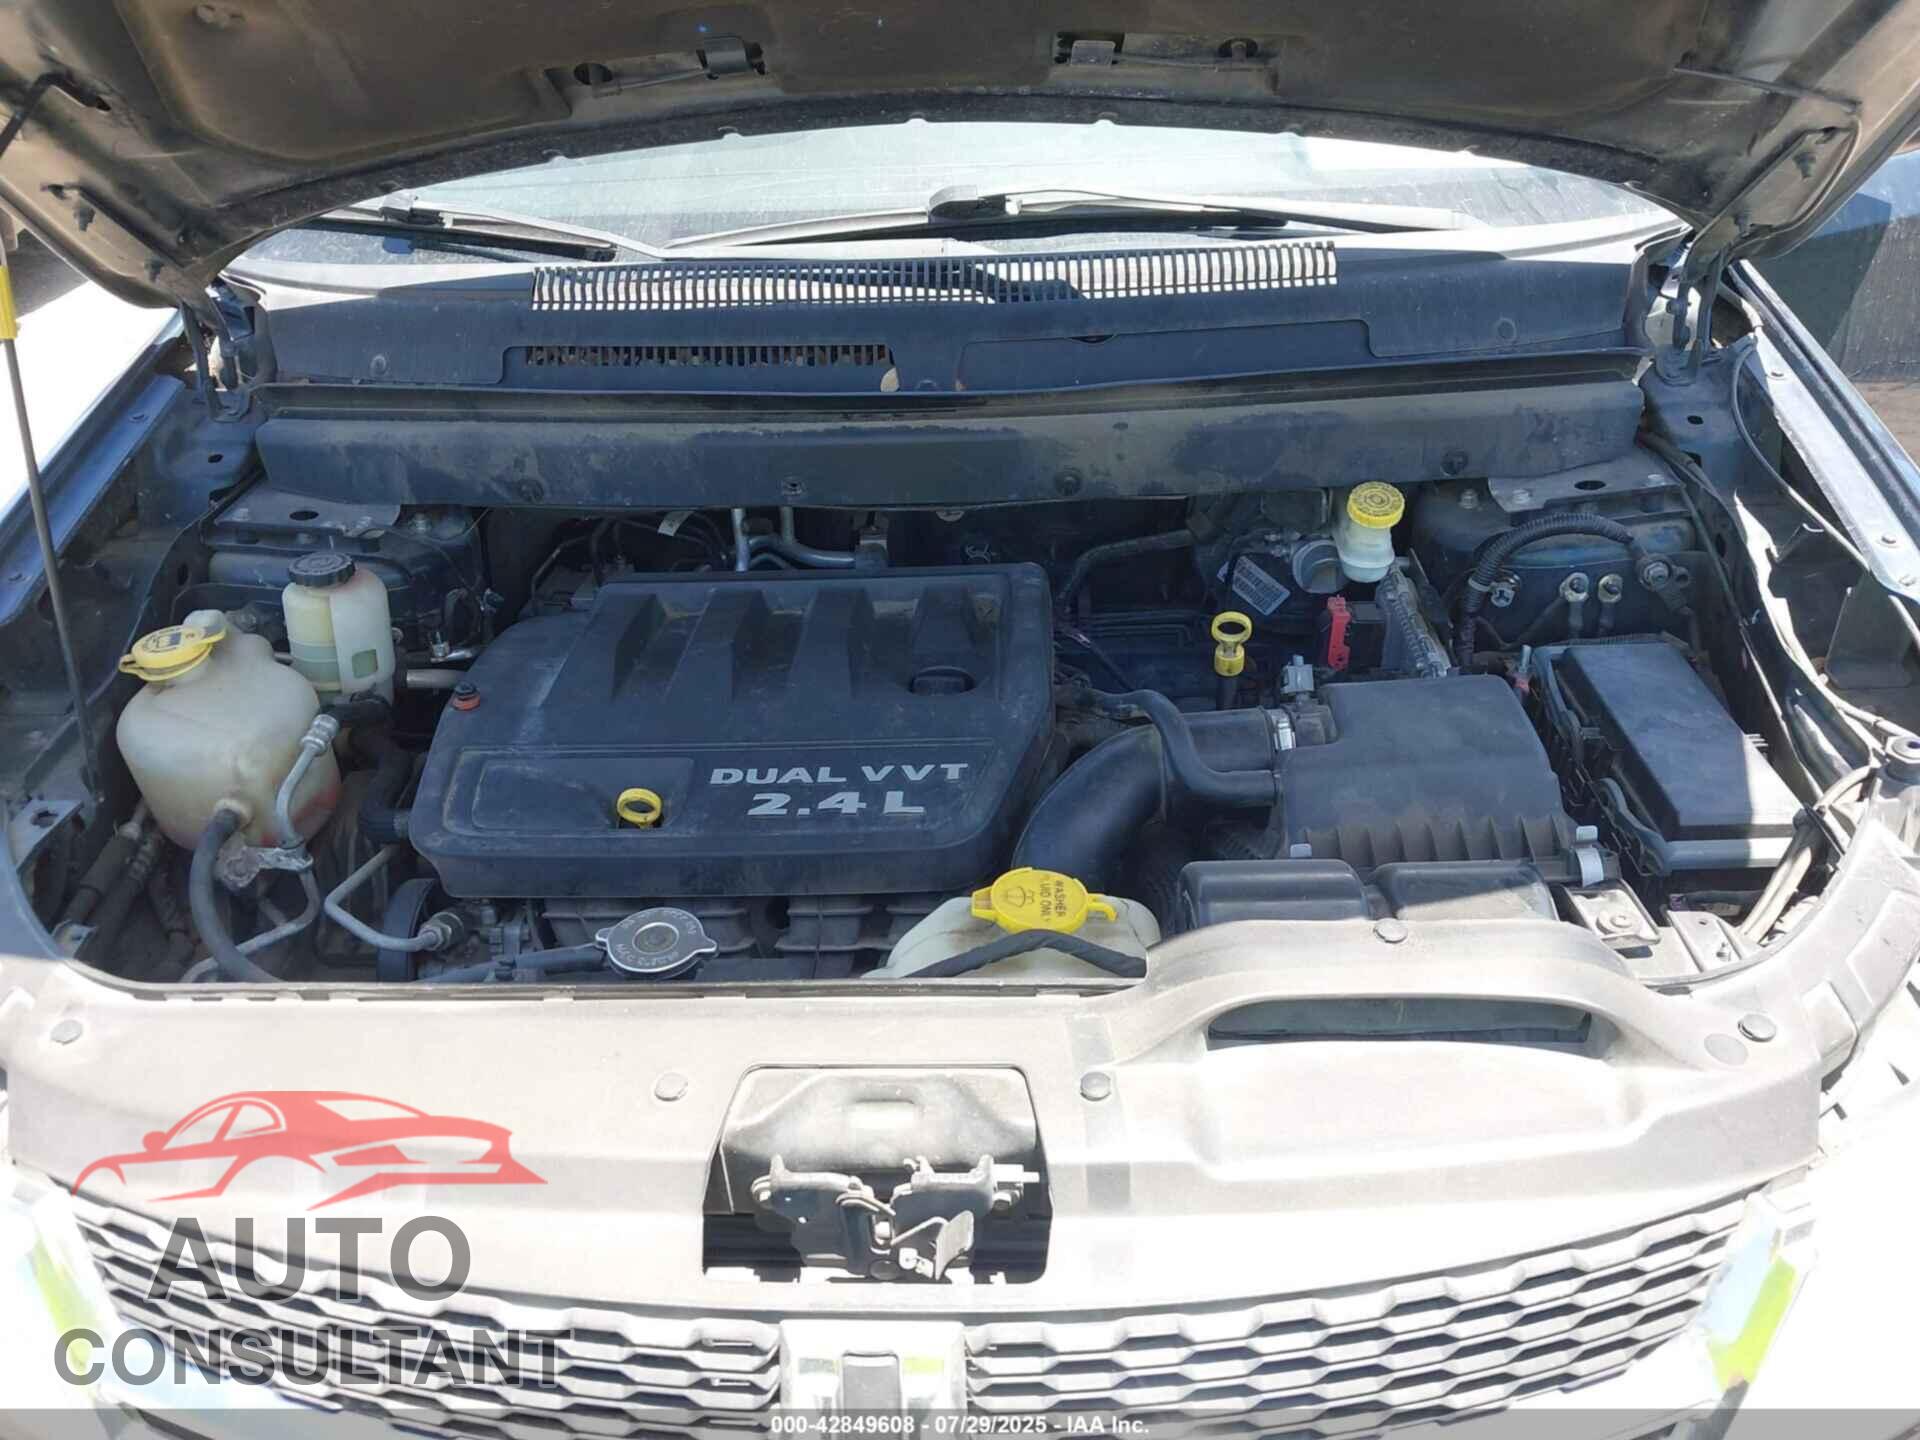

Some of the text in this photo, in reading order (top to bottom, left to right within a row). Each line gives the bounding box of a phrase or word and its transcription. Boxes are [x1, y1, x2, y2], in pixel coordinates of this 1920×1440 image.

[710, 763, 969, 784] DUAL VVT
[748, 791, 926, 815] 2.4 L
[1054, 880, 1067, 917] WASHER
